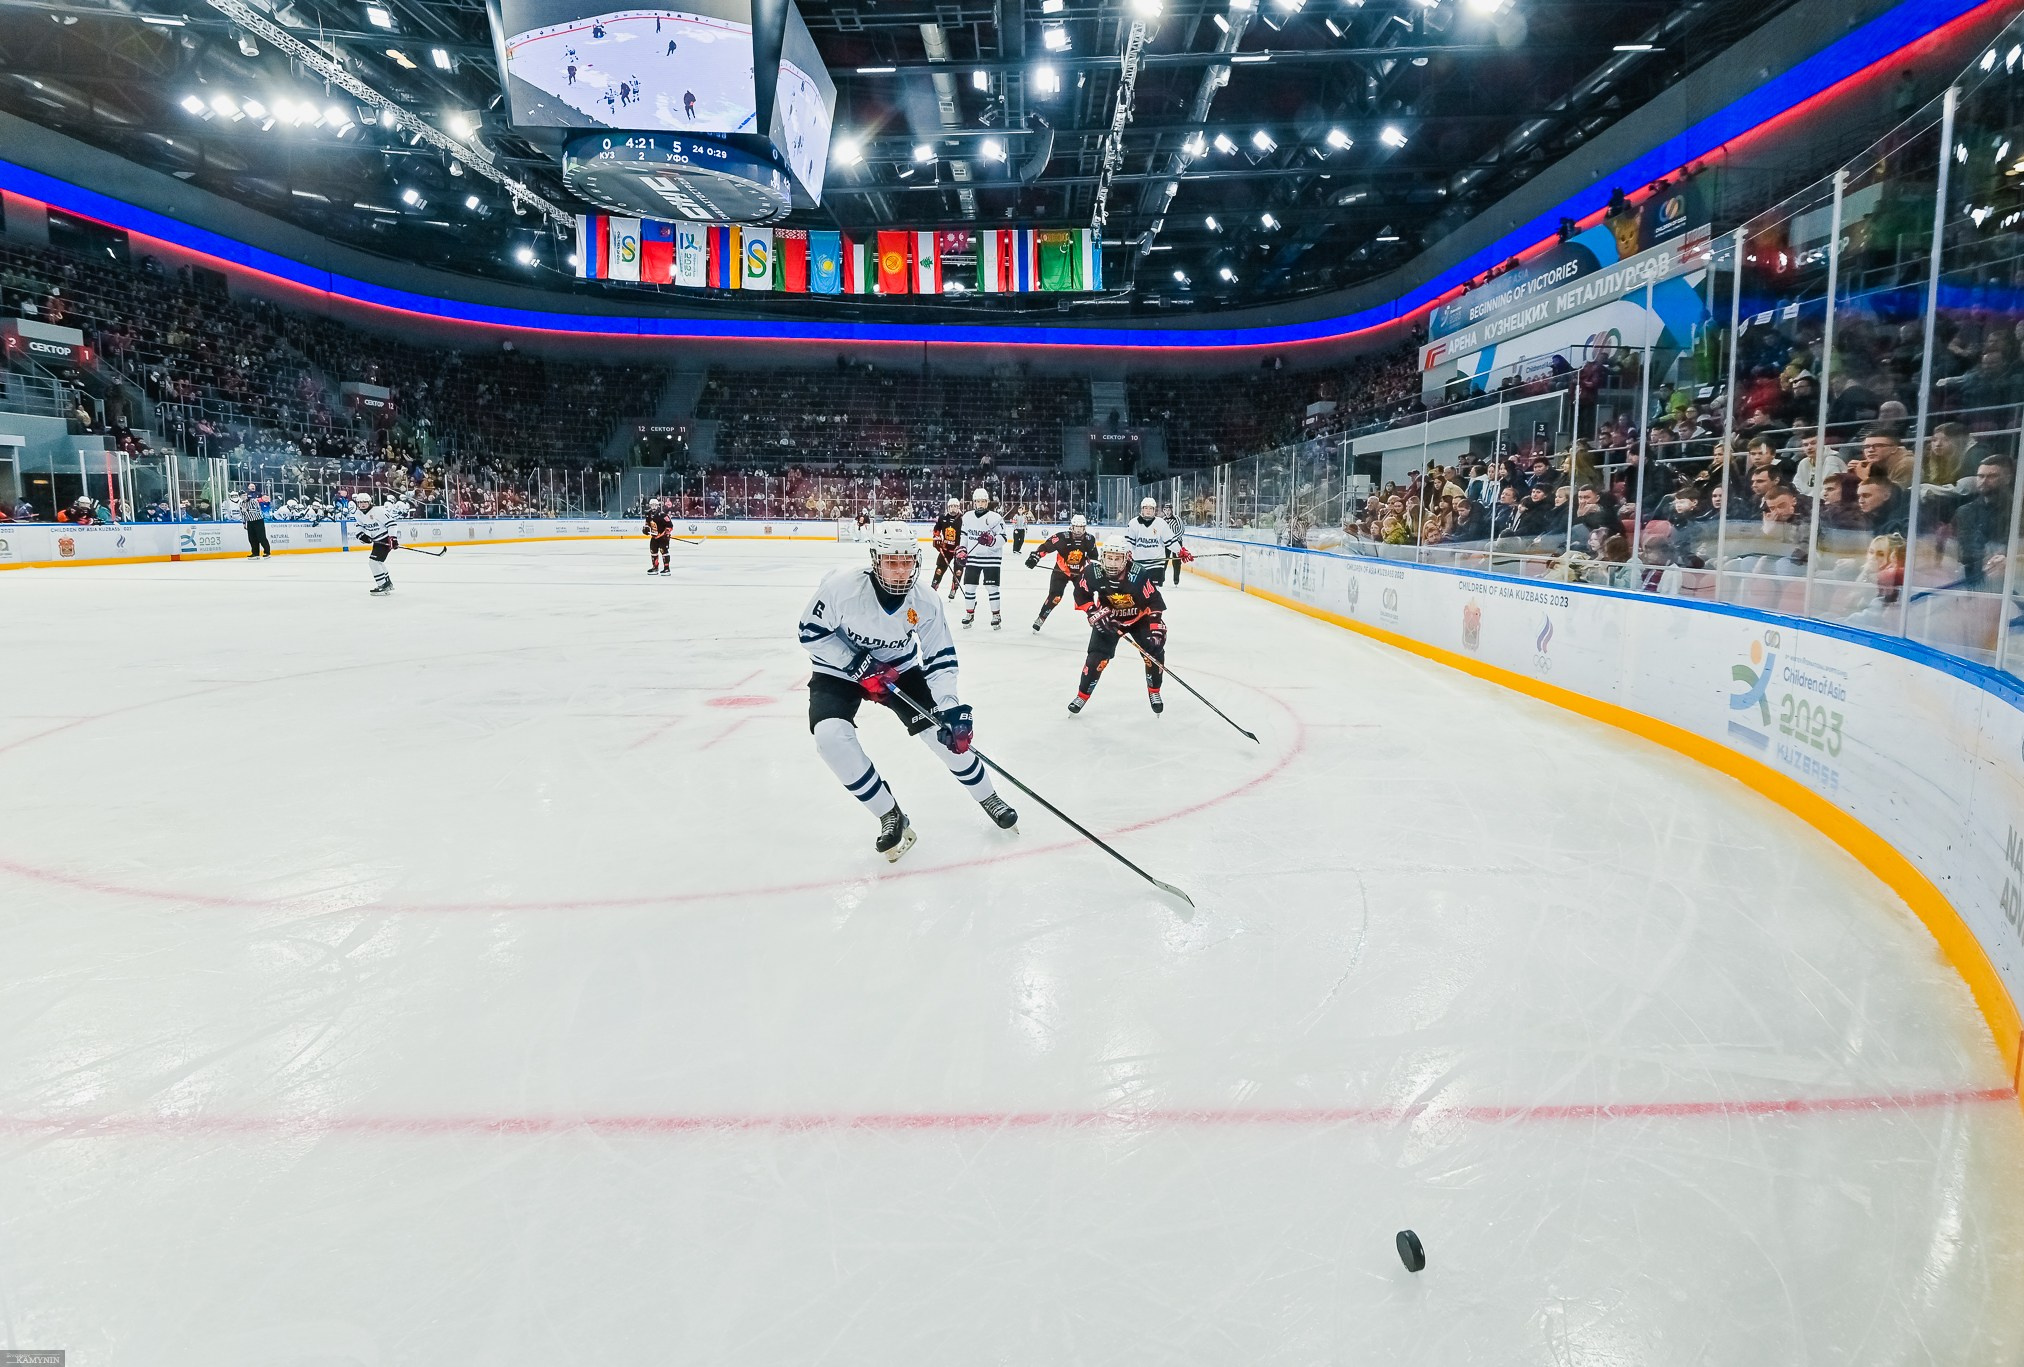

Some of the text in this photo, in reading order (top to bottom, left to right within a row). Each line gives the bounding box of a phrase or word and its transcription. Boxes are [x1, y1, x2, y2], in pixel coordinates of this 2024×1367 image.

[602, 138, 611, 150] 0
[625, 137, 655, 149] 4:21
[673, 140, 682, 153] 5
[692, 145, 727, 159] 24 0:29
[599, 151, 615, 160] КУЗ
[638, 152, 645, 160] 2
[666, 153, 689, 164] УФО
[1469, 289, 1513, 321] BEGINNING
[1513, 283, 1527, 300] OF
[1527, 259, 1578, 294] VICTORIES
[1448, 330, 1478, 355] АРЕНА
[1484, 300, 1550, 341] КУЗНЕЦКИХ
[1556, 252, 1671, 314] МЕТАЛЛУРГОВ
[8, 337, 89, 360] 2 СЕКТОР 1
[364, 399, 385, 408] СЕКТОР
[199, 537, 222, 546] 2023
[1346, 562, 1363, 572] CHILDREN
[1394, 571, 1405, 580] 2023
[1142, 578, 1155, 599] 14
[1459, 580, 1569, 608] CHILDREN OF ASIA KUZBASS 2023
[812, 599, 826, 619] 6
[1783, 666, 1847, 702] Children of Asia
[1779, 694, 1843, 757] 2023
[1778, 744, 1839, 789] KUZBASS
